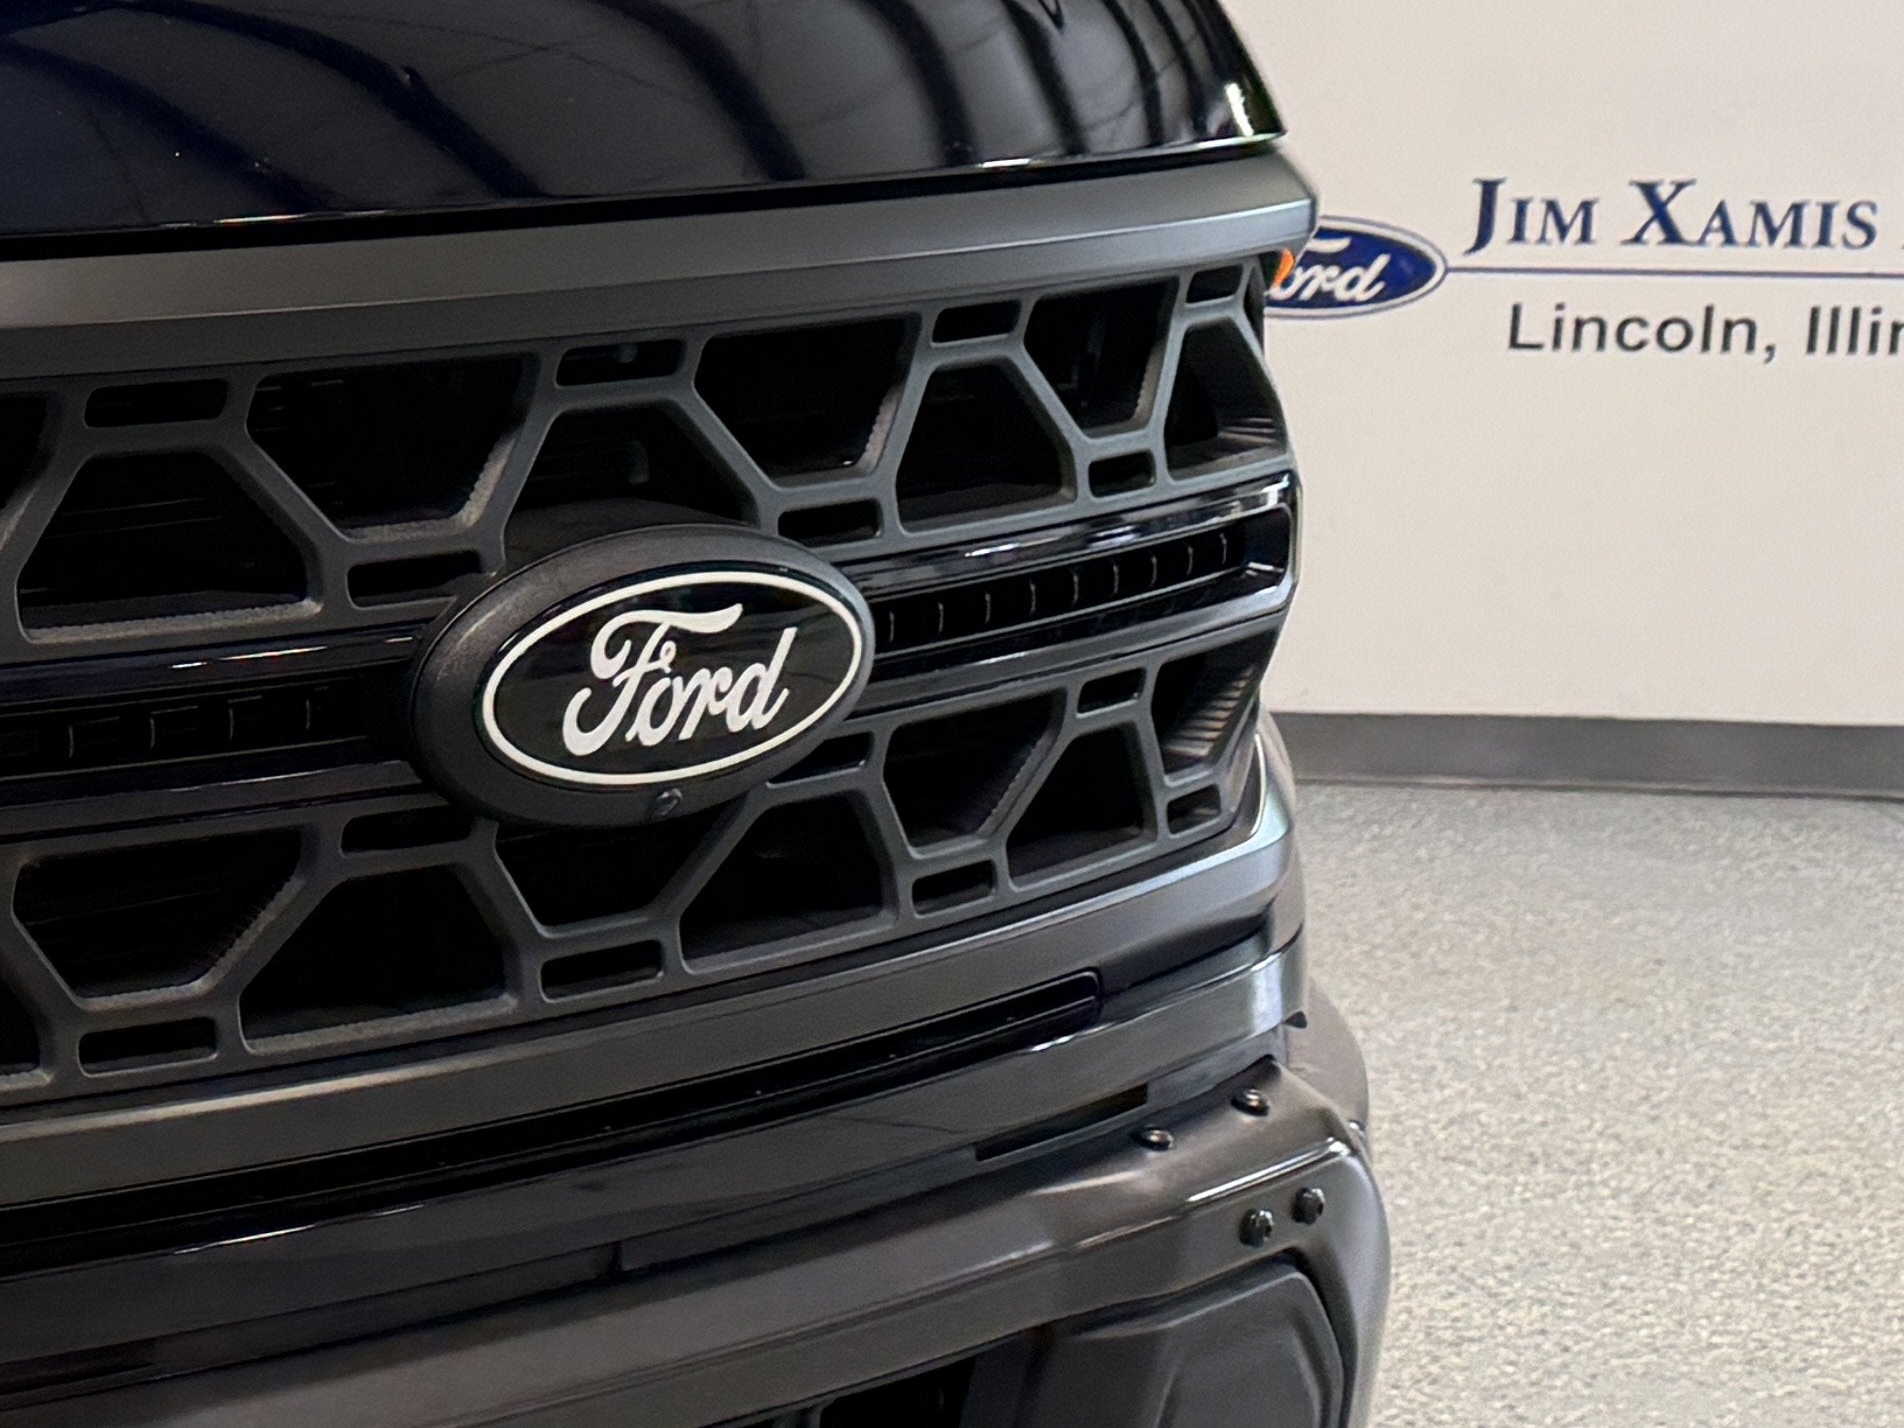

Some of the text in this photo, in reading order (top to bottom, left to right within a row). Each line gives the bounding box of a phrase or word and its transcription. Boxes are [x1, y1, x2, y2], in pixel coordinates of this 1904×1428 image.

[1462, 177, 1879, 256] JIM XAMIS
[1265, 236, 1392, 302] ord
[1508, 302, 1776, 365] Lincoln,
[561, 602, 799, 756] Ford
